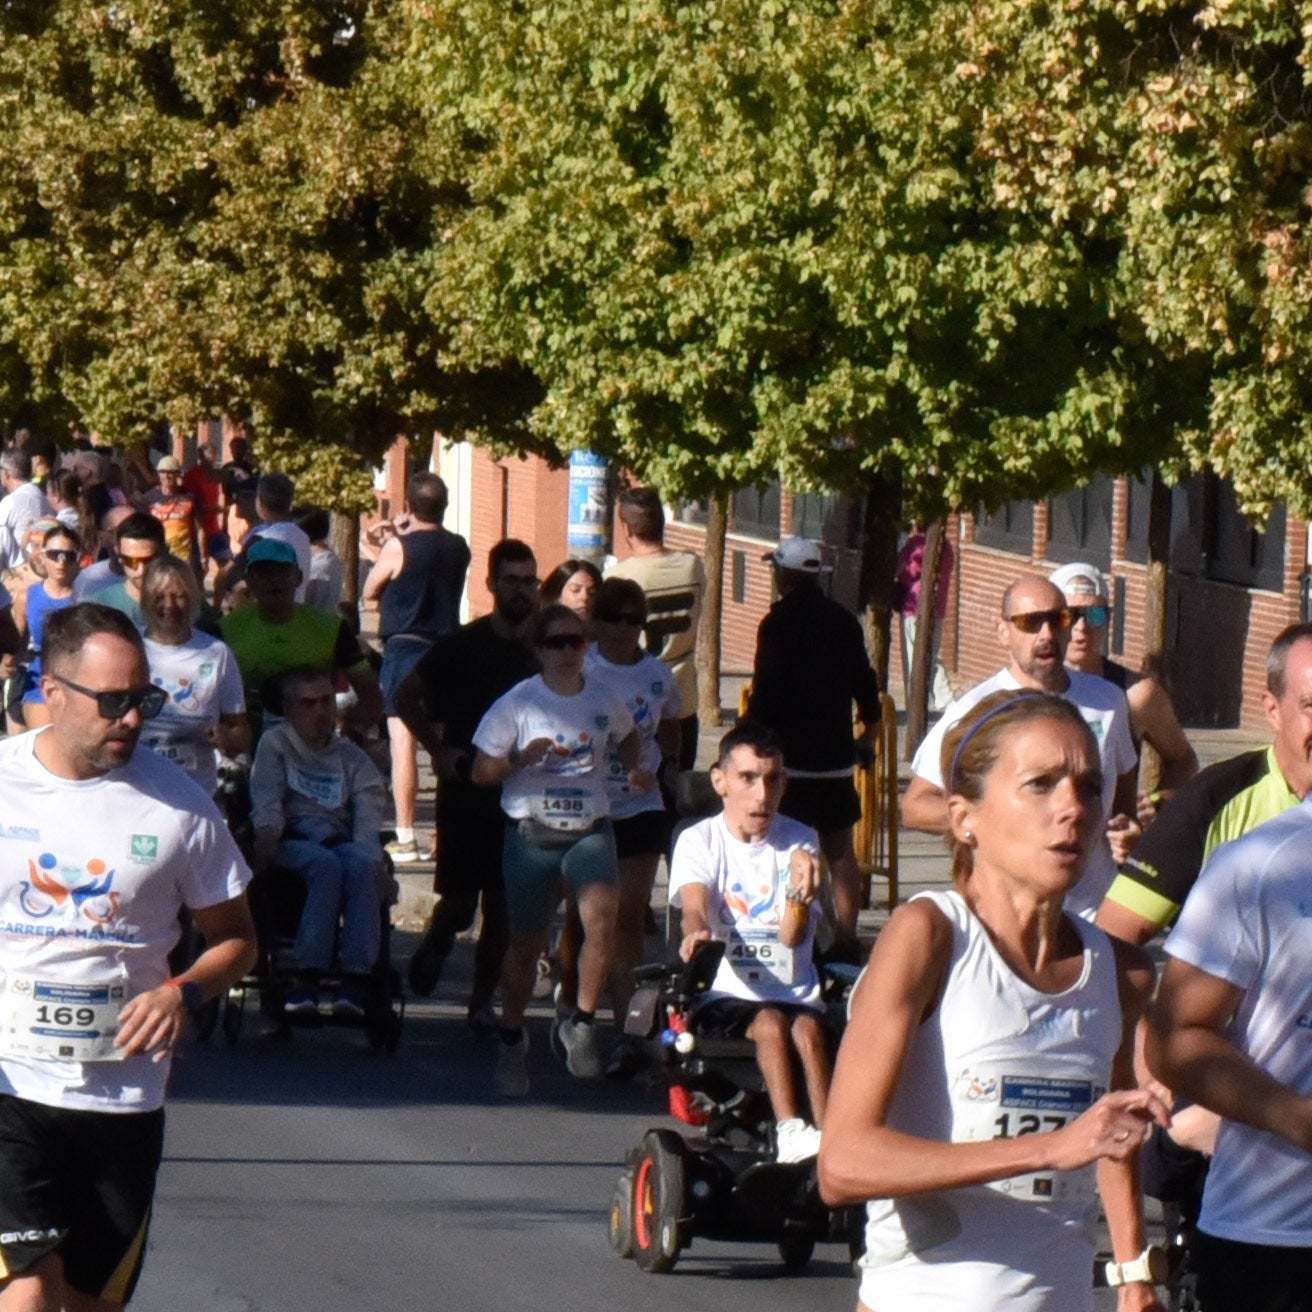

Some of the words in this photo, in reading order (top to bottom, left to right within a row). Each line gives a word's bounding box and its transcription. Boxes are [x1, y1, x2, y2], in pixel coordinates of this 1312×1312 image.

[732, 944, 772, 958] 496
[36, 1005, 95, 1027] 169
[993, 1113, 1072, 1140] 127
